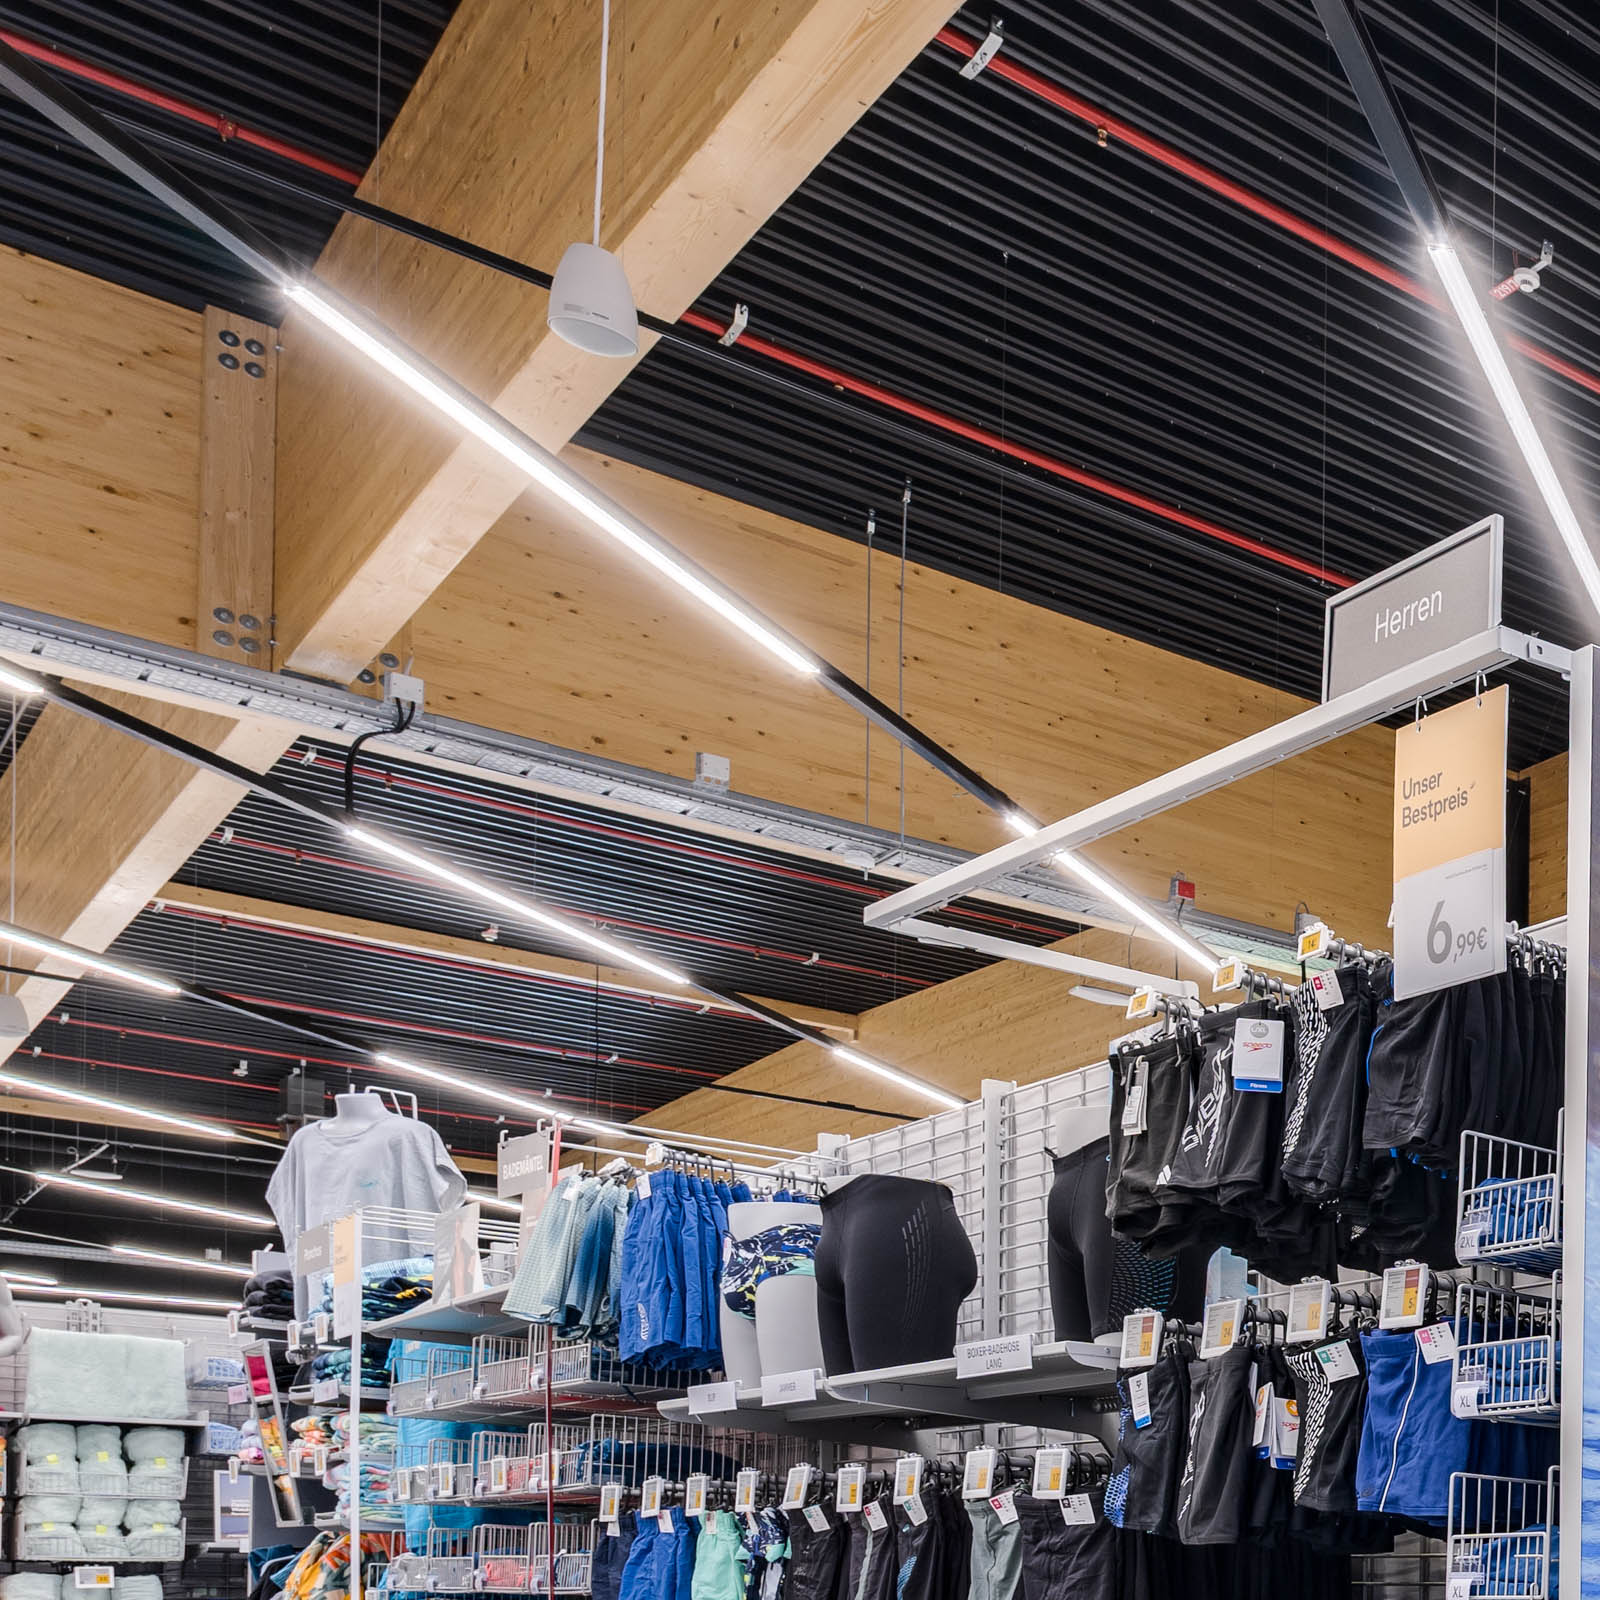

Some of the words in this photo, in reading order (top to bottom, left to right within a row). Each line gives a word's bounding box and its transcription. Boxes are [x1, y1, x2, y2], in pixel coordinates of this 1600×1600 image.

[1375, 590, 1442, 643] Herren
[1402, 771, 1443, 800] Unser
[1402, 787, 1468, 828] Bestpreis
[1427, 900, 1488, 965] 6,99€
[1459, 1236, 1475, 1249] 2XL
[966, 1341, 1021, 1359] BOXER-BADEHOSE
[985, 1357, 1002, 1370] LANG
[1459, 1395, 1471, 1408] XL
[1452, 1586, 1463, 1598] XL
